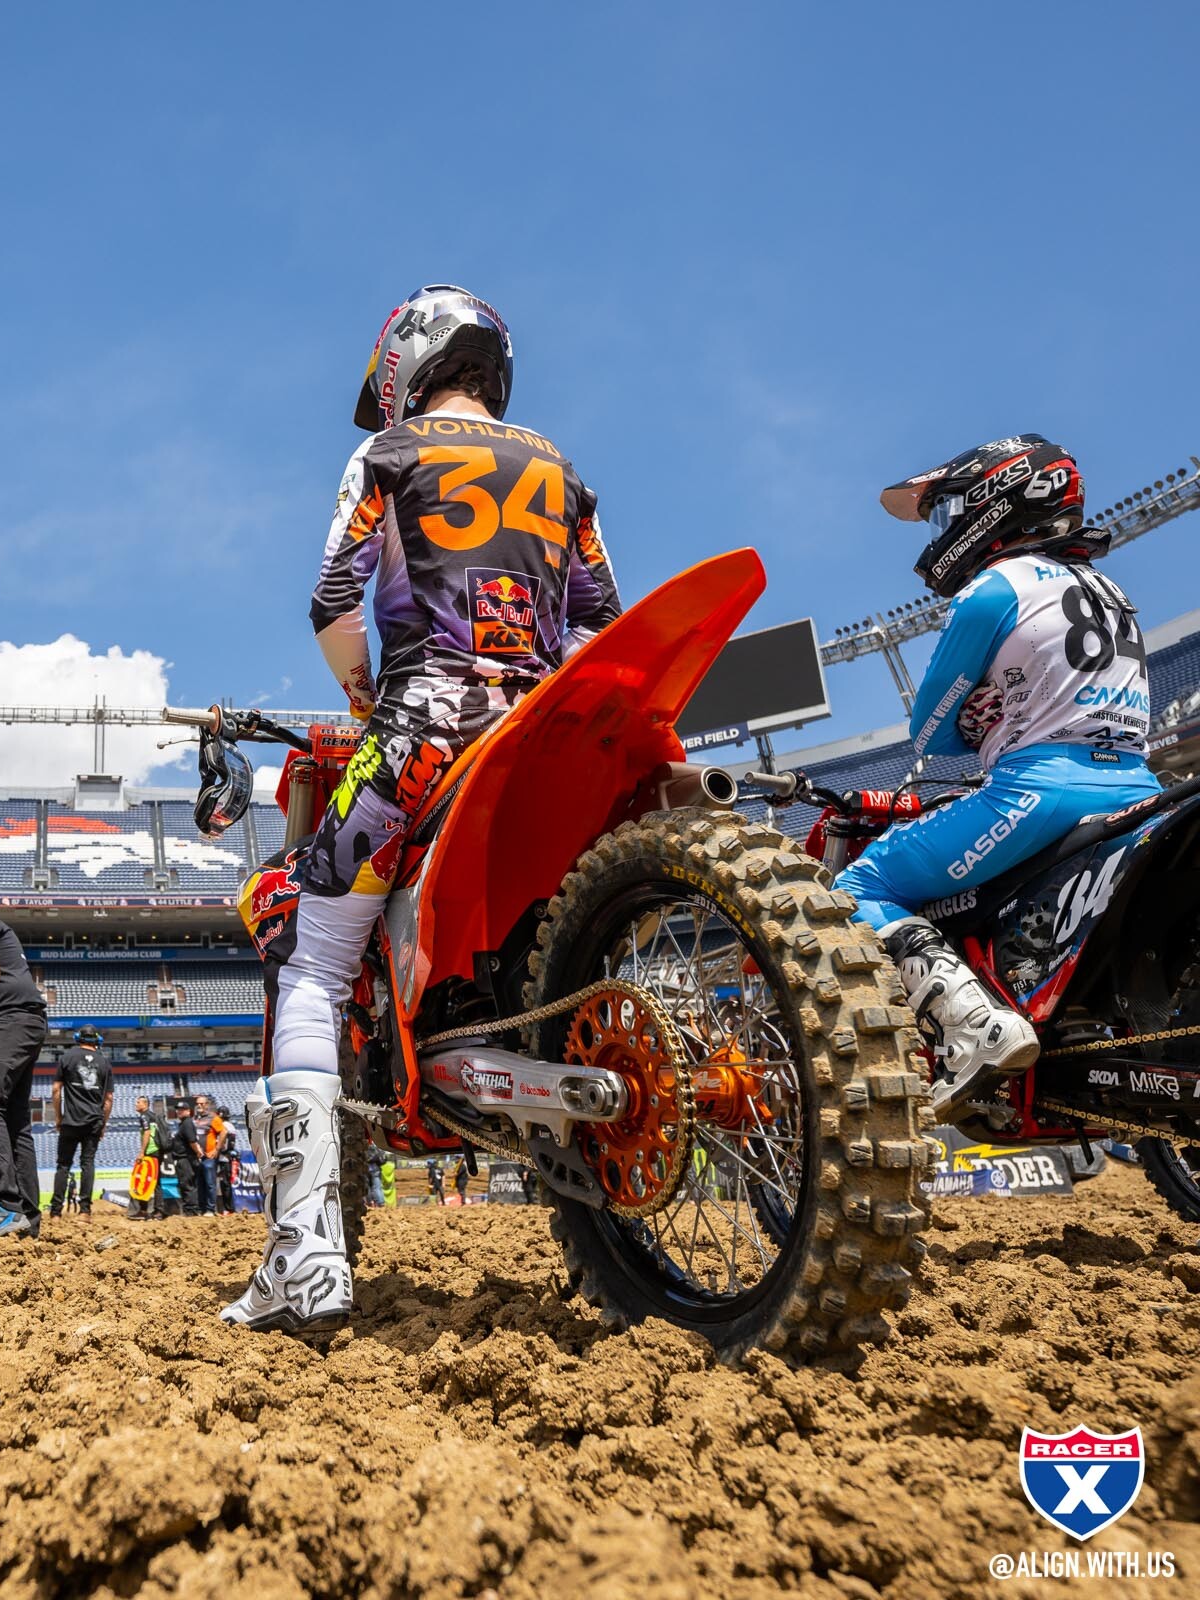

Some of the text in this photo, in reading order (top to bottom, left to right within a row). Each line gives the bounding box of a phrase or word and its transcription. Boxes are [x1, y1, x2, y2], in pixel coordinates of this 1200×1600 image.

[965, 456, 1033, 507] EKS
[418, 445, 569, 570] 34
[506, 604, 534, 627] Bull
[1061, 584, 1147, 680] 84
[932, 676, 970, 719] VEHICLES
[1087, 709, 1148, 731] ERSTOCK VEHICLES
[704, 727, 740, 746] FIELD
[395, 741, 446, 817] KTM
[946, 791, 1041, 880] GASGAS
[25, 898, 54, 906] TAYLOR
[1054, 846, 1127, 944] 84
[40, 951, 162, 959] BUD LIGHT CHAMPIONS CLUB
[1088, 1069, 1180, 1097] SKDA Mika
[274, 1118, 311, 1150] FOX
[342, 1270, 351, 1299] FOX
